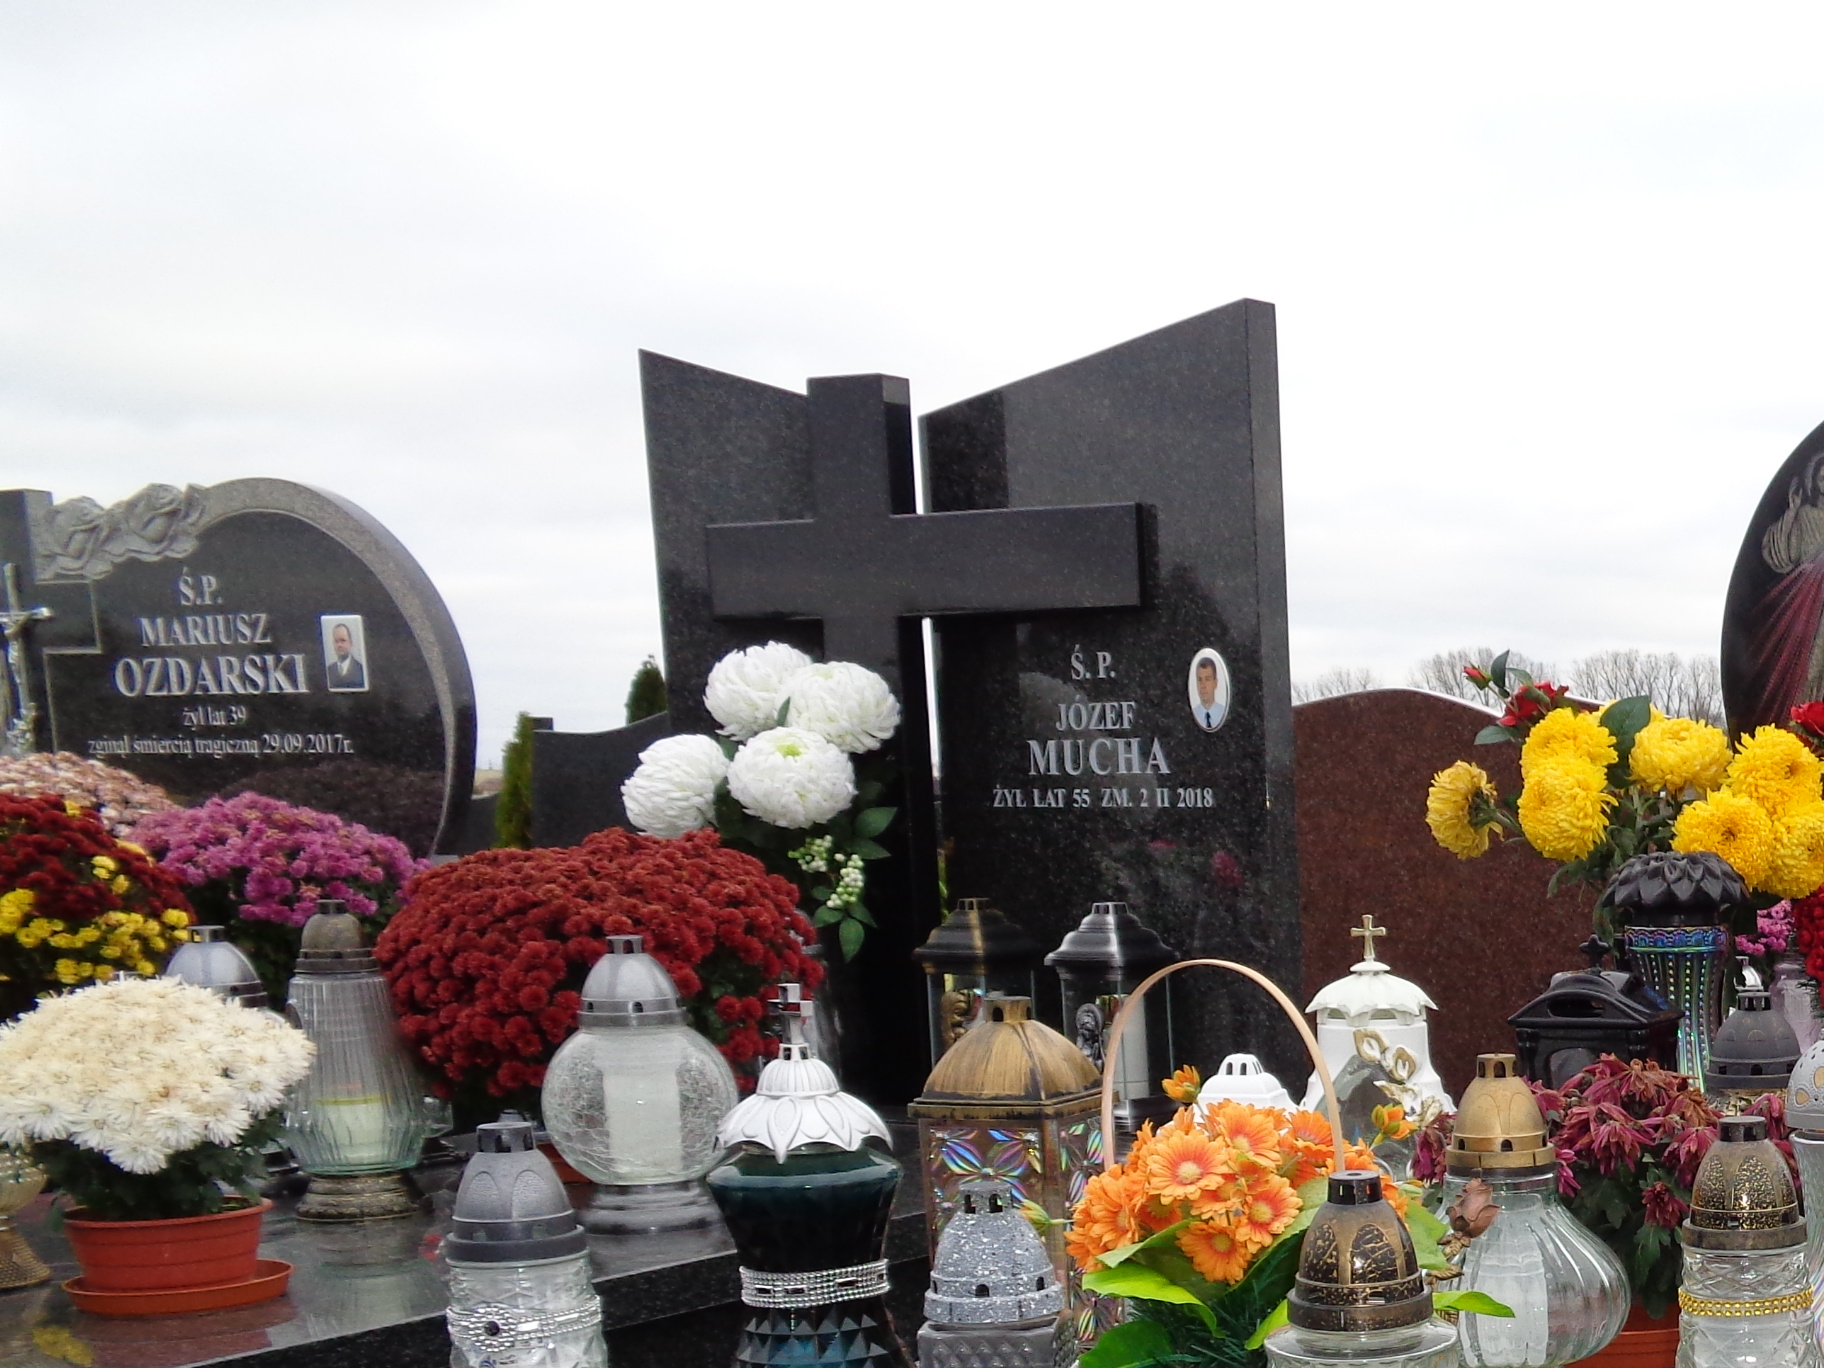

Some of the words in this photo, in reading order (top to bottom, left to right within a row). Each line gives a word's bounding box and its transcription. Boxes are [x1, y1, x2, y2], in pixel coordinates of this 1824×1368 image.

[139, 613, 272, 647] MARIUSZ
[114, 653, 310, 698] OZDARSKI
[1070, 644, 1091, 680] Ś.
[1096, 651, 1116, 679] P.
[207, 705, 226, 726] lat
[228, 705, 246, 726] 39
[1055, 694, 1136, 731] JÓZEF
[1026, 736, 1171, 776] MUCHA
[992, 784, 1027, 808] ŻYŁ
[1032, 788, 1066, 808] LAT
[1072, 788, 1091, 808] 55
[1101, 787, 1132, 808] ZM.
[1139, 787, 1149, 808] 2
[1156, 787, 1170, 808] II
[1176, 786, 1214, 808] 2018
